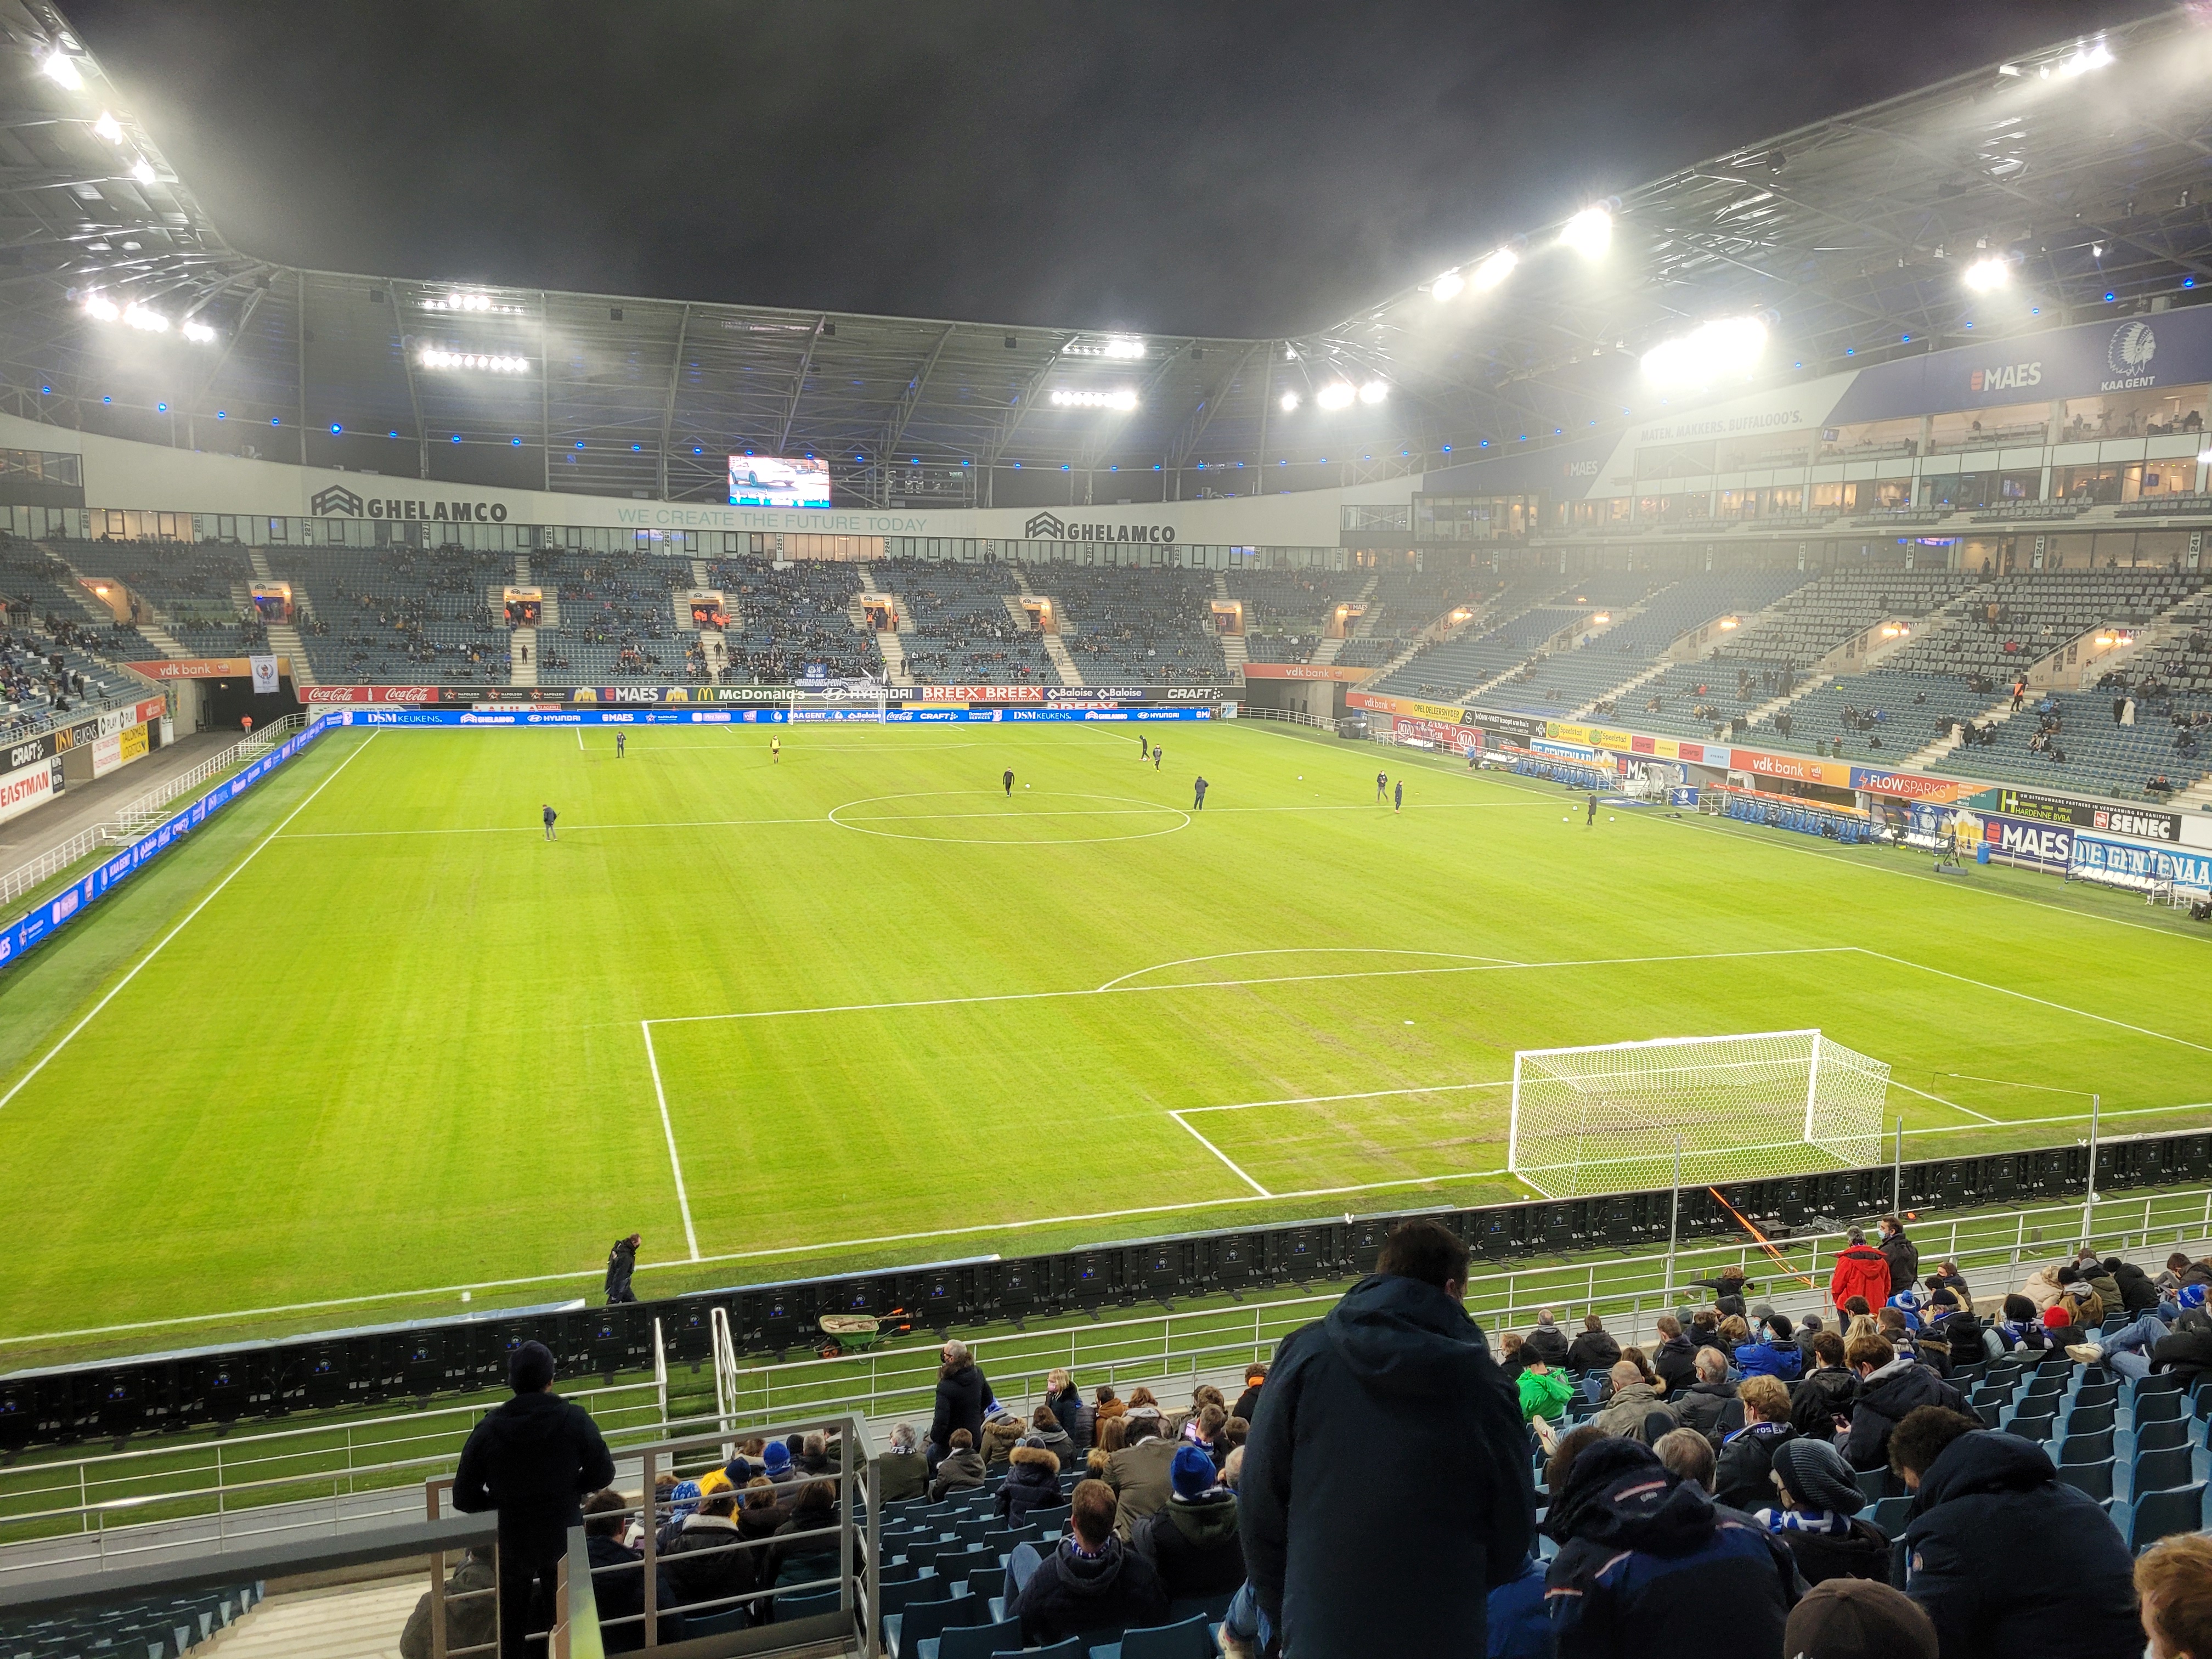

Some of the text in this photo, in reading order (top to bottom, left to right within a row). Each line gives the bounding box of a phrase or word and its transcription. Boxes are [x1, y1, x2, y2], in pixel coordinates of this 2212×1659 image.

[1984, 362, 2042, 391] MAES
[2101, 375, 2157, 391] KAA GENT
[1641, 427, 1674, 442] MATEN.
[1676, 421, 1725, 438] MAKKERS.
[1570, 460, 1598, 476] MAES
[367, 498, 507, 522] GHELAMCO
[618, 509, 927, 532] WE CREATE THE FUTURE TODAY
[1068, 523, 1175, 543] GHELAMCO
[2190, 540, 2199, 560] 124
[160, 663, 212, 676] vdk bank
[1286, 667, 1329, 678] vdk bank
[308, 687, 354, 701] Coca-Cola
[385, 687, 428, 701] Coca-Cola
[616, 687, 659, 701] MAES
[719, 688, 805, 701] McDonald's
[923, 687, 979, 698] BREEX
[986, 687, 1041, 698] BREEX
[1060, 688, 1093, 697] Baloise
[1110, 688, 1142, 697] Baloise
[1167, 689, 1212, 699] CRAFT
[1364, 698, 1388, 710] vdk bank
[1414, 704, 1425, 713] OPEL
[368, 714, 397, 723] DSM
[1014, 711, 1036, 719] DSM
[1500, 716, 1513, 726] koopt
[1519, 720, 1530, 728] huis
[1400, 725, 1411, 735] KIA
[1560, 725, 1583, 737] Speelstad
[55, 727, 73, 754] DSM
[1459, 734, 1472, 745] KIA
[1601, 732, 1627, 743] Speelstad
[11, 743, 37, 768] CRAFT
[1752, 757, 1804, 777] vdk bank
[1, 770, 49, 808] EASTMAN
[1870, 774, 1946, 798] FLOWSPARKS
[2015, 807, 2052, 820] HARDENNE
[2053, 812, 2071, 822] BVBA
[2066, 800, 2091, 809] PARTNERS
[2100, 805, 2135, 815] VERWARMING
[2145, 812, 2171, 821] SANITAIR
[2110, 814, 2171, 839] SENEC
[2002, 824, 2070, 861] MAES
